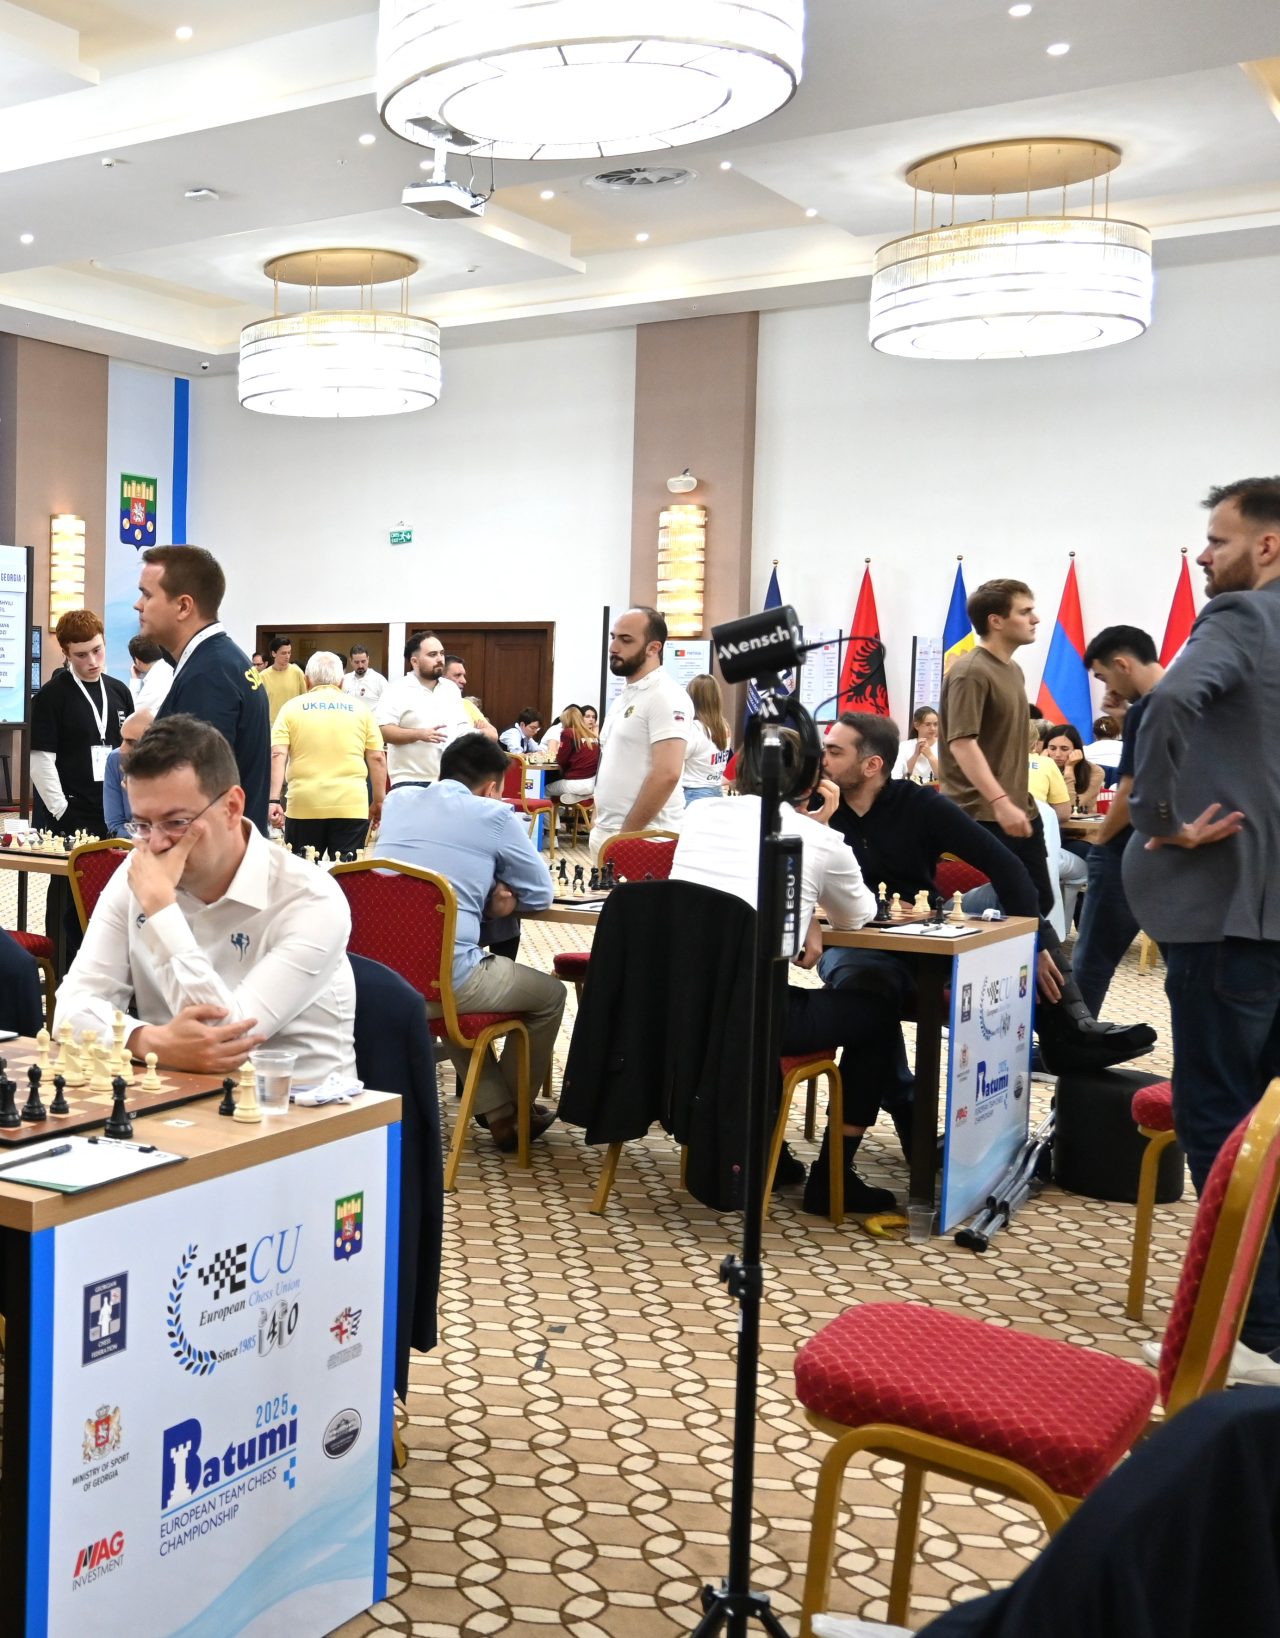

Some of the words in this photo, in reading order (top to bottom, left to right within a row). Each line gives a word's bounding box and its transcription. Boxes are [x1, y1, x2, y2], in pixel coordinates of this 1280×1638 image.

[719, 625, 791, 660] Mensch
[302, 702, 354, 712] UKRAINE
[786, 874, 795, 909] ECU
[198, 1224, 303, 1301] ECU
[199, 1299, 246, 1327] European
[249, 1287, 273, 1307] Chess
[276, 1278, 301, 1296] Union
[218, 1345, 239, 1363] Since
[238, 1335, 257, 1354] 1985
[256, 1393, 289, 1428] 2025
[72, 1466, 100, 1486] MINISTRY
[101, 1461, 110, 1472] OF
[110, 1452, 130, 1469] SPORT
[161, 1404, 298, 1510] Batumi
[83, 1480, 92, 1491] OF
[93, 1470, 119, 1488] GEORGIA
[160, 1499, 216, 1538] EUROPEAN
[219, 1483, 246, 1507] TEAM
[247, 1466, 277, 1493] CHESS
[160, 1504, 239, 1557] CHAMPIONSHIP
[72, 1554, 125, 1592] INVESTMENT
